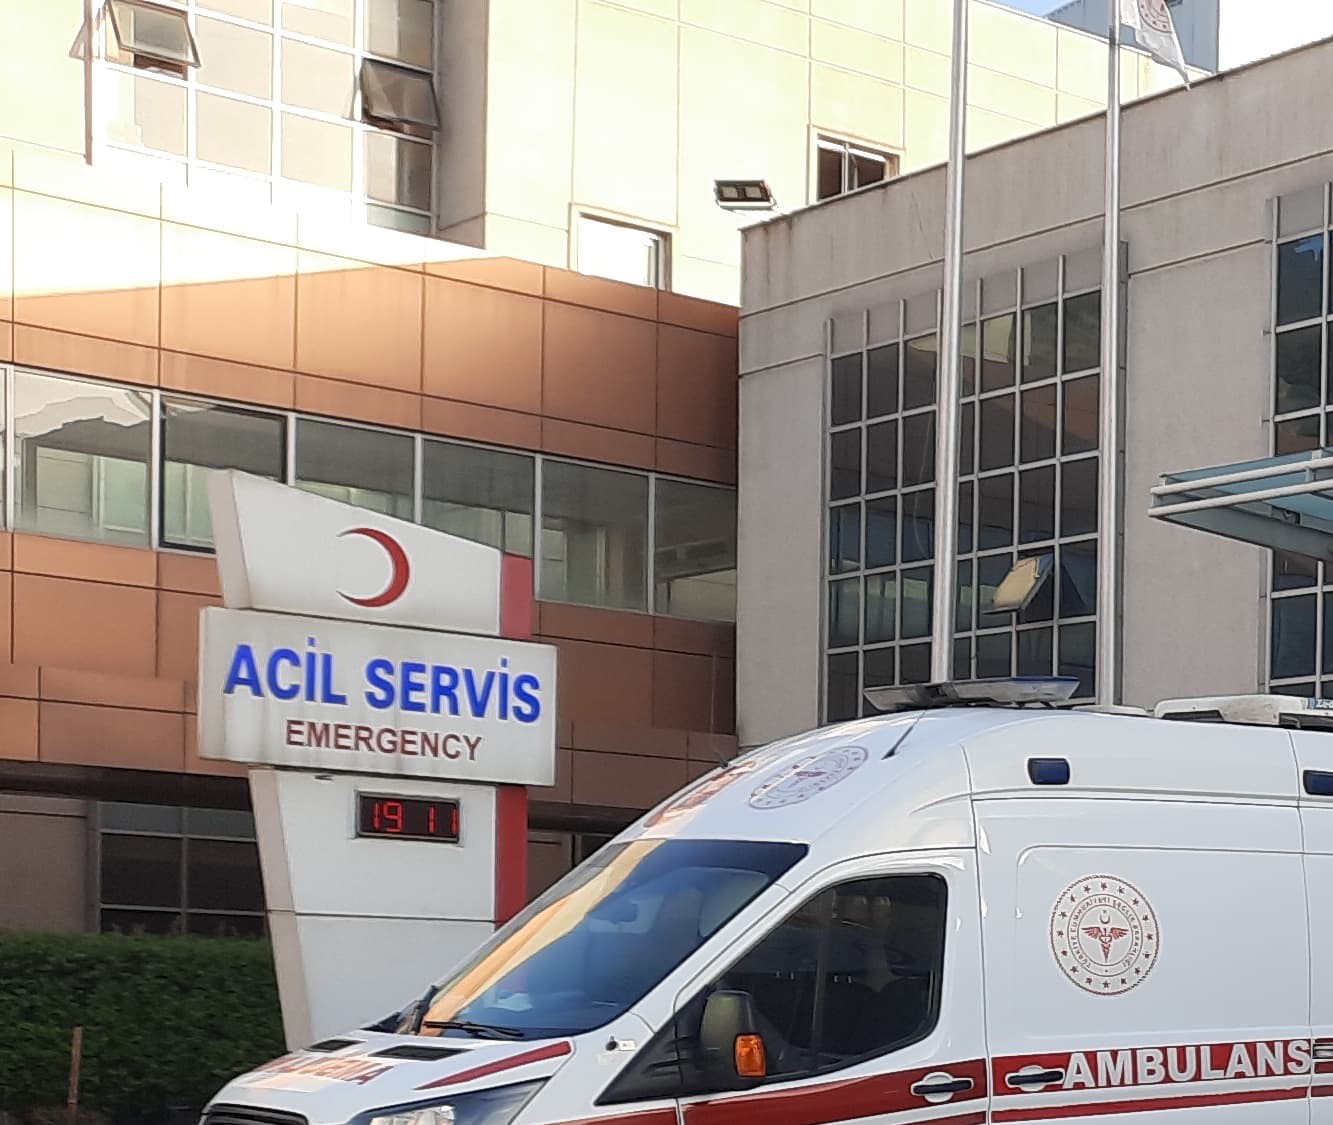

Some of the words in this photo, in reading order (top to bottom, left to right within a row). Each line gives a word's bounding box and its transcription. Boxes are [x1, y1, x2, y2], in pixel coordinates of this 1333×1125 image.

[223, 637, 348, 705] ACİL
[364, 657, 541, 723] SERVİS
[285, 719, 482, 761] EMERGENCY
[1062, 1039, 1313, 1090] AMBULANS
